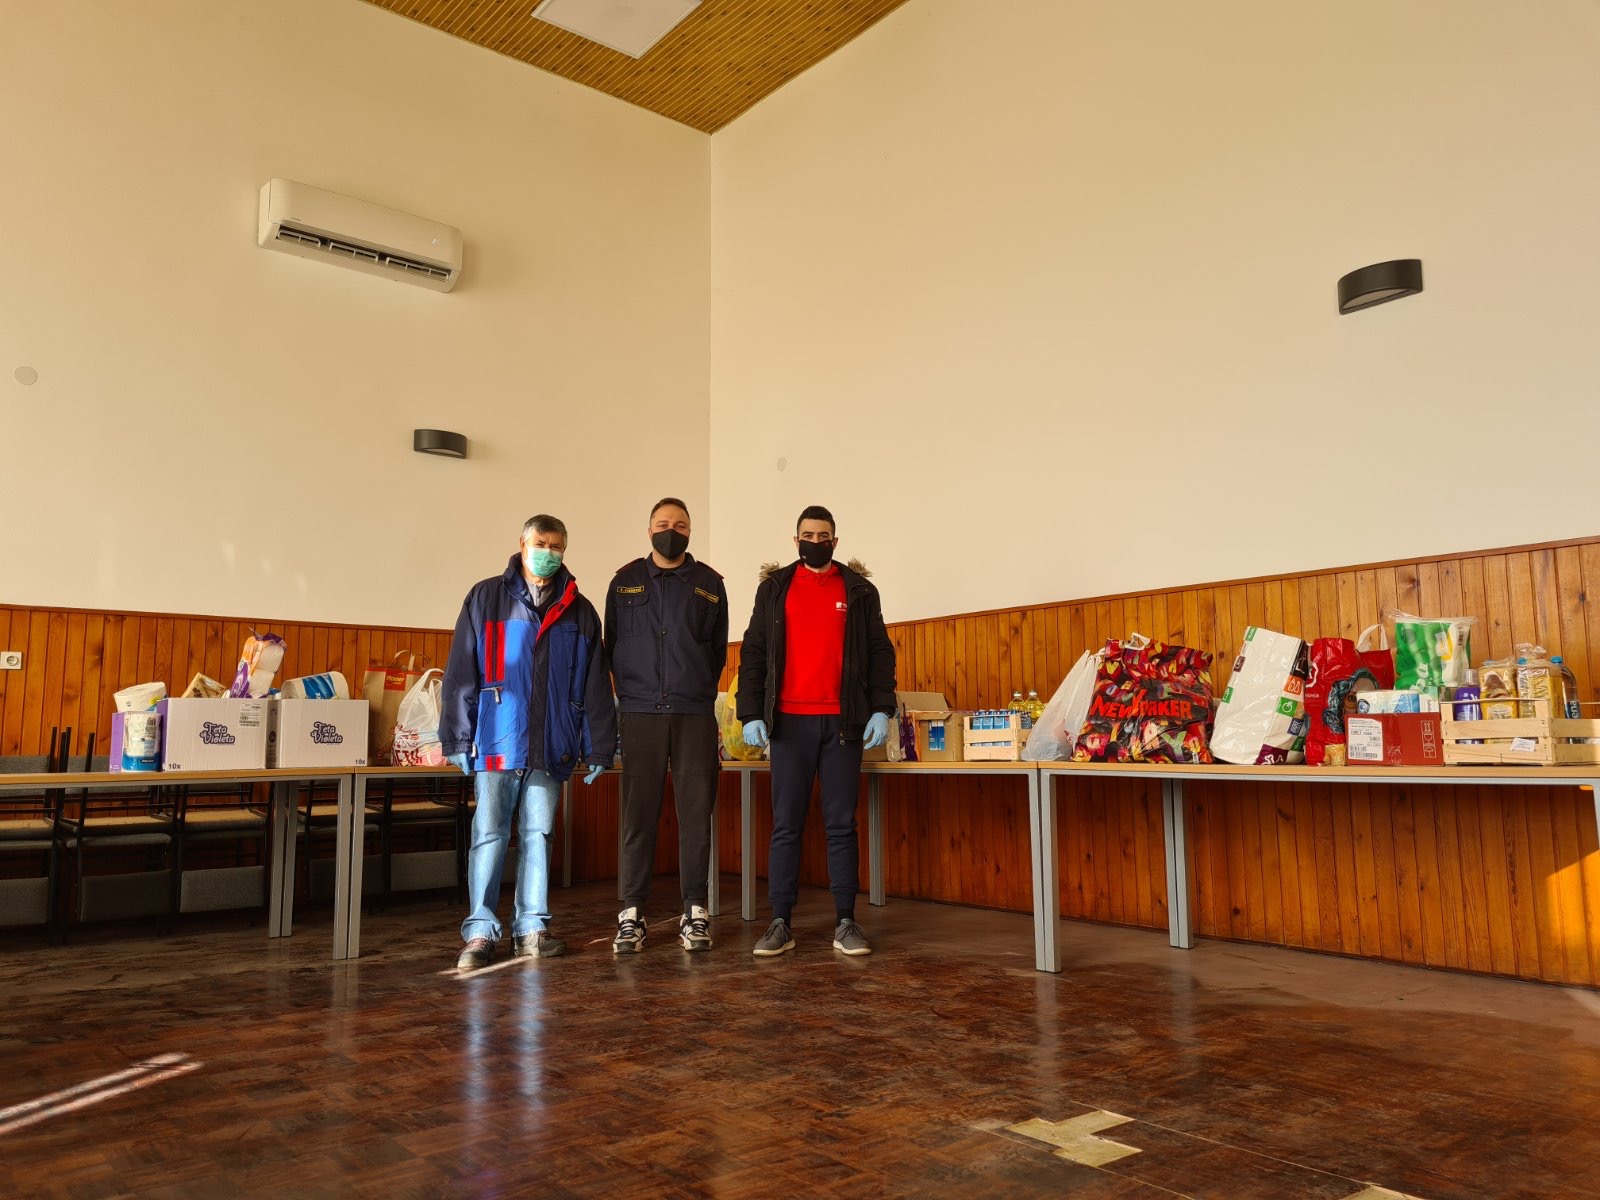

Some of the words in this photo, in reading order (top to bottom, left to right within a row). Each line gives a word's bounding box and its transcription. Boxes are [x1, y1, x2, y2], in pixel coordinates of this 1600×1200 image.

[203, 721, 227, 734] Teta
[313, 721, 336, 734] Teta
[199, 730, 236, 744] Violeta
[310, 730, 343, 744] Violeta
